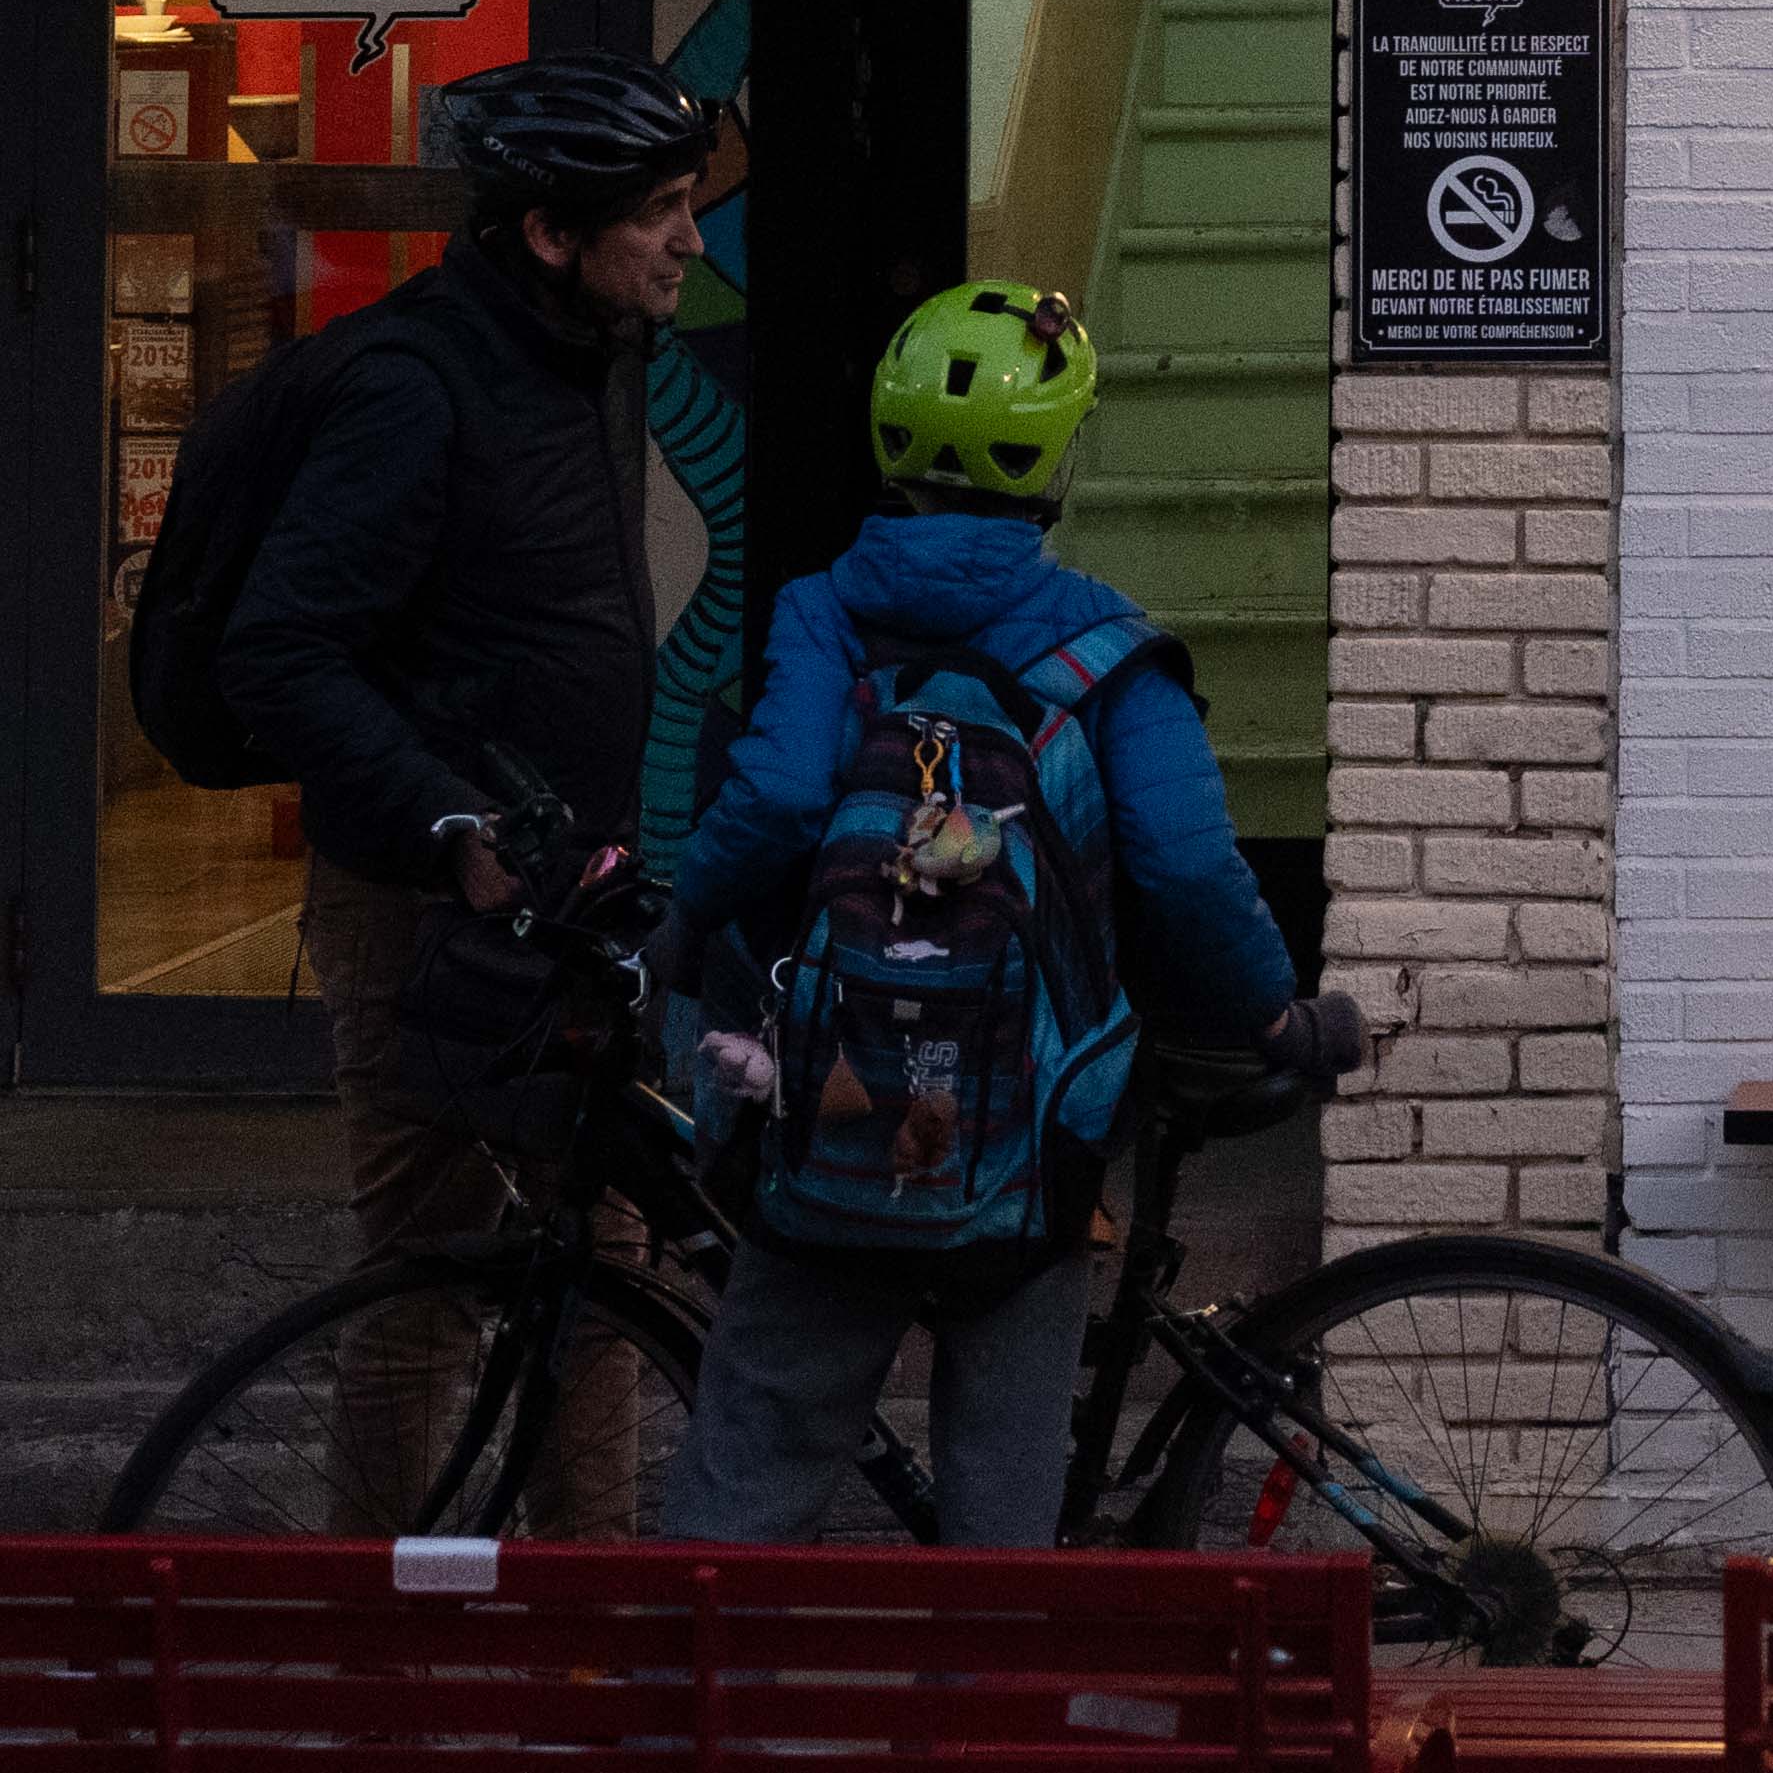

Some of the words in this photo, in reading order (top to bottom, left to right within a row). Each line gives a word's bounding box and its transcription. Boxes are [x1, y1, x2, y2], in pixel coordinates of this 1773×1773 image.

[1372, 36, 1390, 53] LA
[1392, 33, 1487, 53] TRANQUILLITÉ
[1491, 36, 1507, 53] ET
[1511, 36, 1527, 53] LE
[1530, 36, 1590, 53] RESPECT
[1399, 59, 1417, 76] DE
[1421, 59, 1466, 76] NOTRE
[1468, 56, 1562, 76] COMMUNAUTÉ
[1411, 84, 1435, 101] EST
[1438, 84, 1483, 101] NOTRE
[1486, 81, 1551, 101] PRIORITÉ.
[1406, 107, 1486, 125] AIDEZ-NOUS
[1490, 104, 1500, 125] À
[1503, 107, 1557, 125] GARDER
[1403, 131, 1430, 149] NOS
[1434, 131, 1487, 149] VOISINS
[1491, 131, 1558, 149] HEUREUX.
[1372, 268, 1428, 291] MERCI
[1433, 268, 1456, 291] DE
[1461, 268, 1485, 291] NE
[1490, 268, 1524, 291] PAS
[1528, 268, 1590, 291] FUMER
[1371, 297, 1425, 316] DEVANT
[1429, 297, 1474, 316] NOTRE
[1478, 294, 1590, 316] ÉTABLISSEMENT
[1387, 325, 1423, 340] MERCI
[1425, 325, 1441, 340] DE
[1443, 325, 1478, 340] VOTRE
[1481, 322, 1575, 340] COMPRÉHENSION
